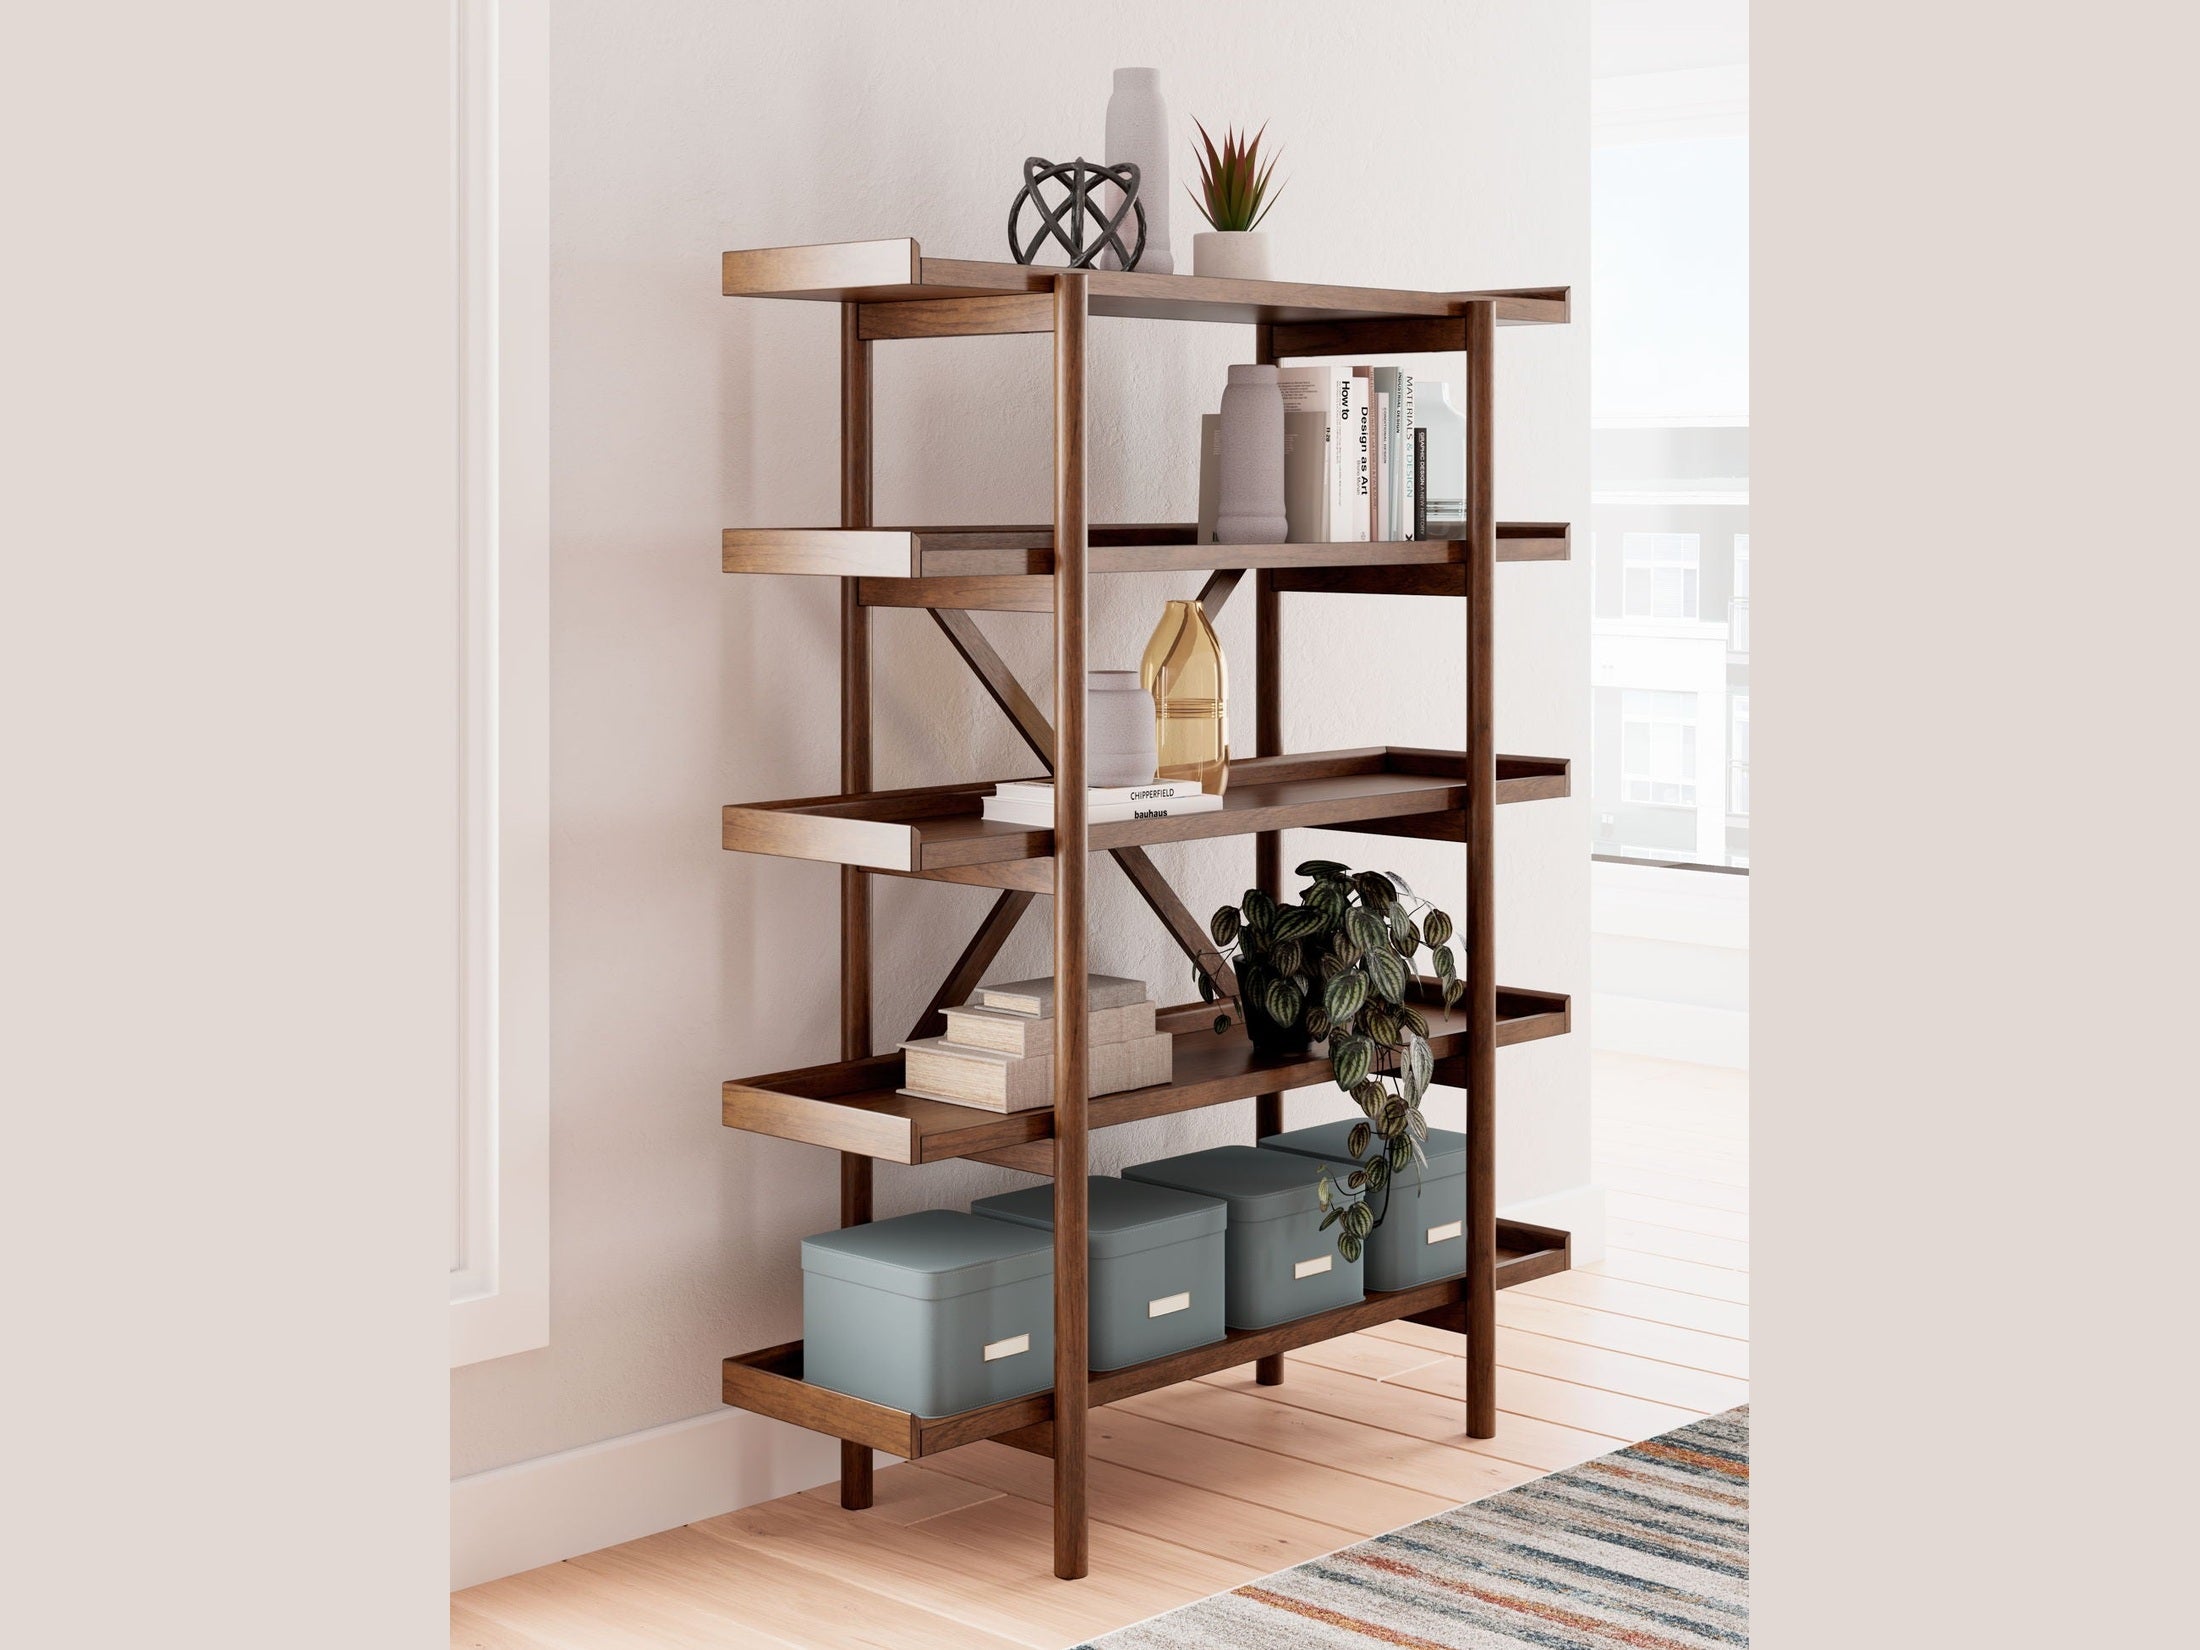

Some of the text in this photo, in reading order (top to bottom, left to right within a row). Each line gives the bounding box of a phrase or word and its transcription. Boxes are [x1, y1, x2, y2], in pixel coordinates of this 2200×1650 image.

[1341, 381, 1350, 420] How to
[1359, 406, 1368, 495] Design as Art
[1406, 442, 1413, 451] &
[1130, 788, 1175, 801] CHIPPERFIELD
[1134, 810, 1168, 819] bauhaus
